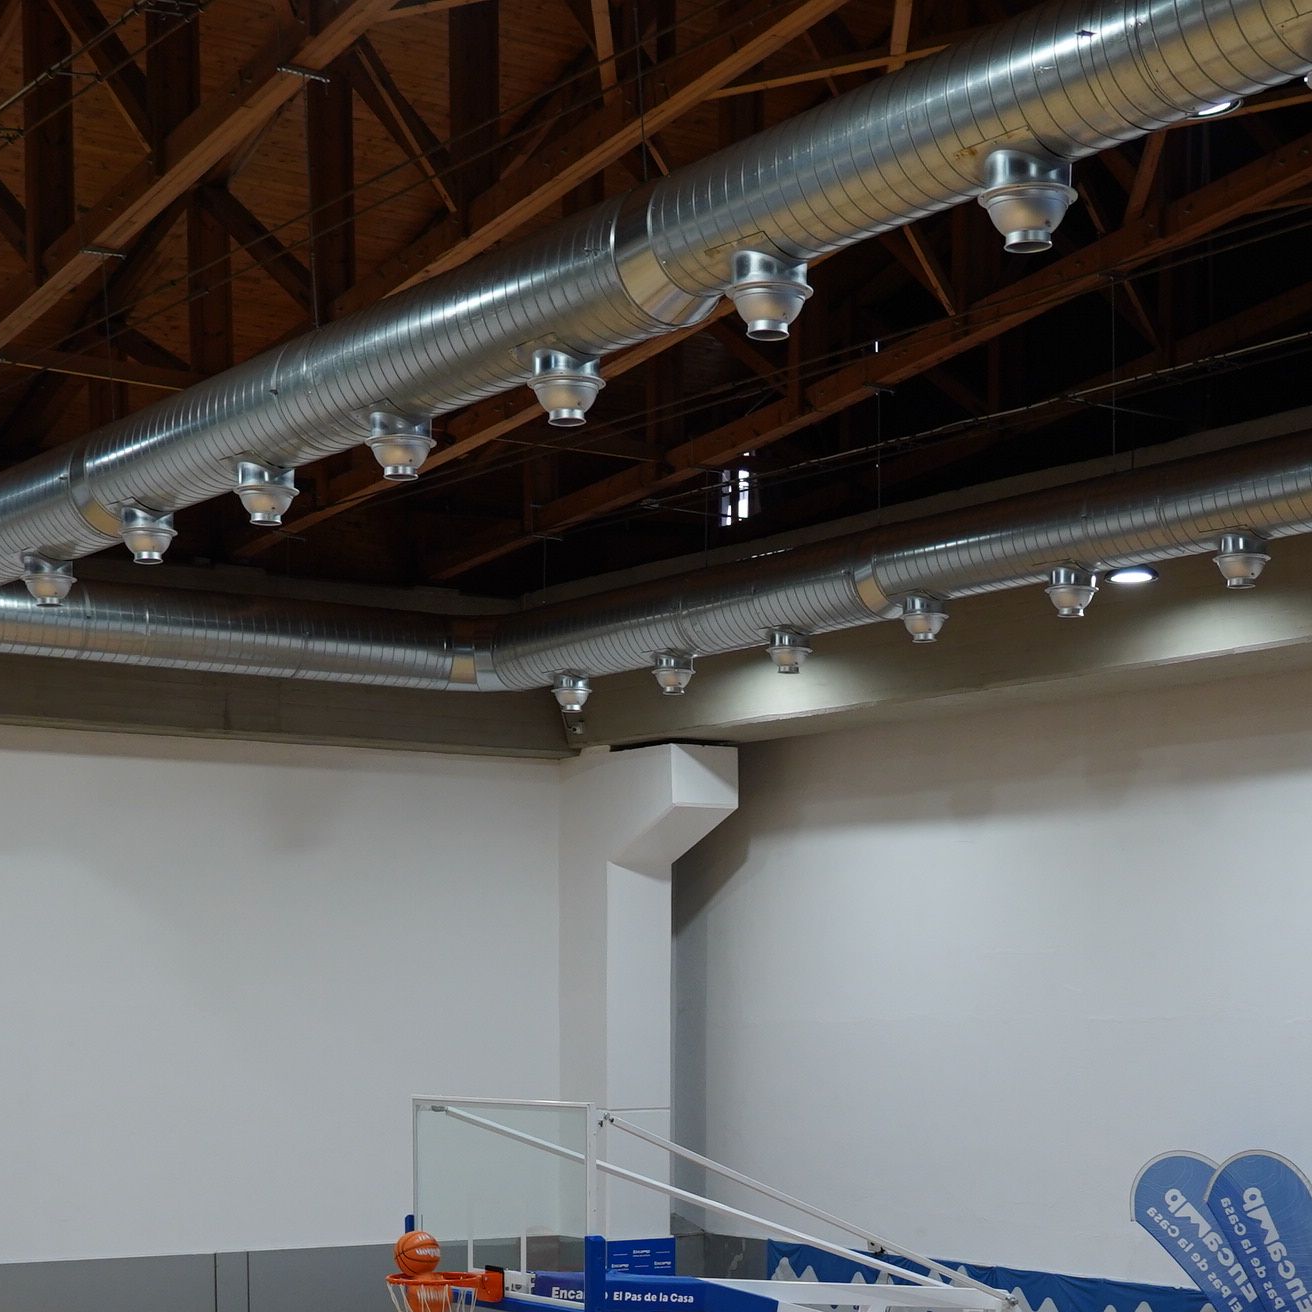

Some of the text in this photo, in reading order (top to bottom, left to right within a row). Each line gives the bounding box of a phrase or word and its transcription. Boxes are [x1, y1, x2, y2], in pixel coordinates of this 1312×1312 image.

[613, 1291, 623, 1301] El
[624, 1291, 642, 1302] Pas
[644, 1292, 657, 1302] de
[659, 1292, 668, 1302] la
[670, 1293, 694, 1304] Casa
